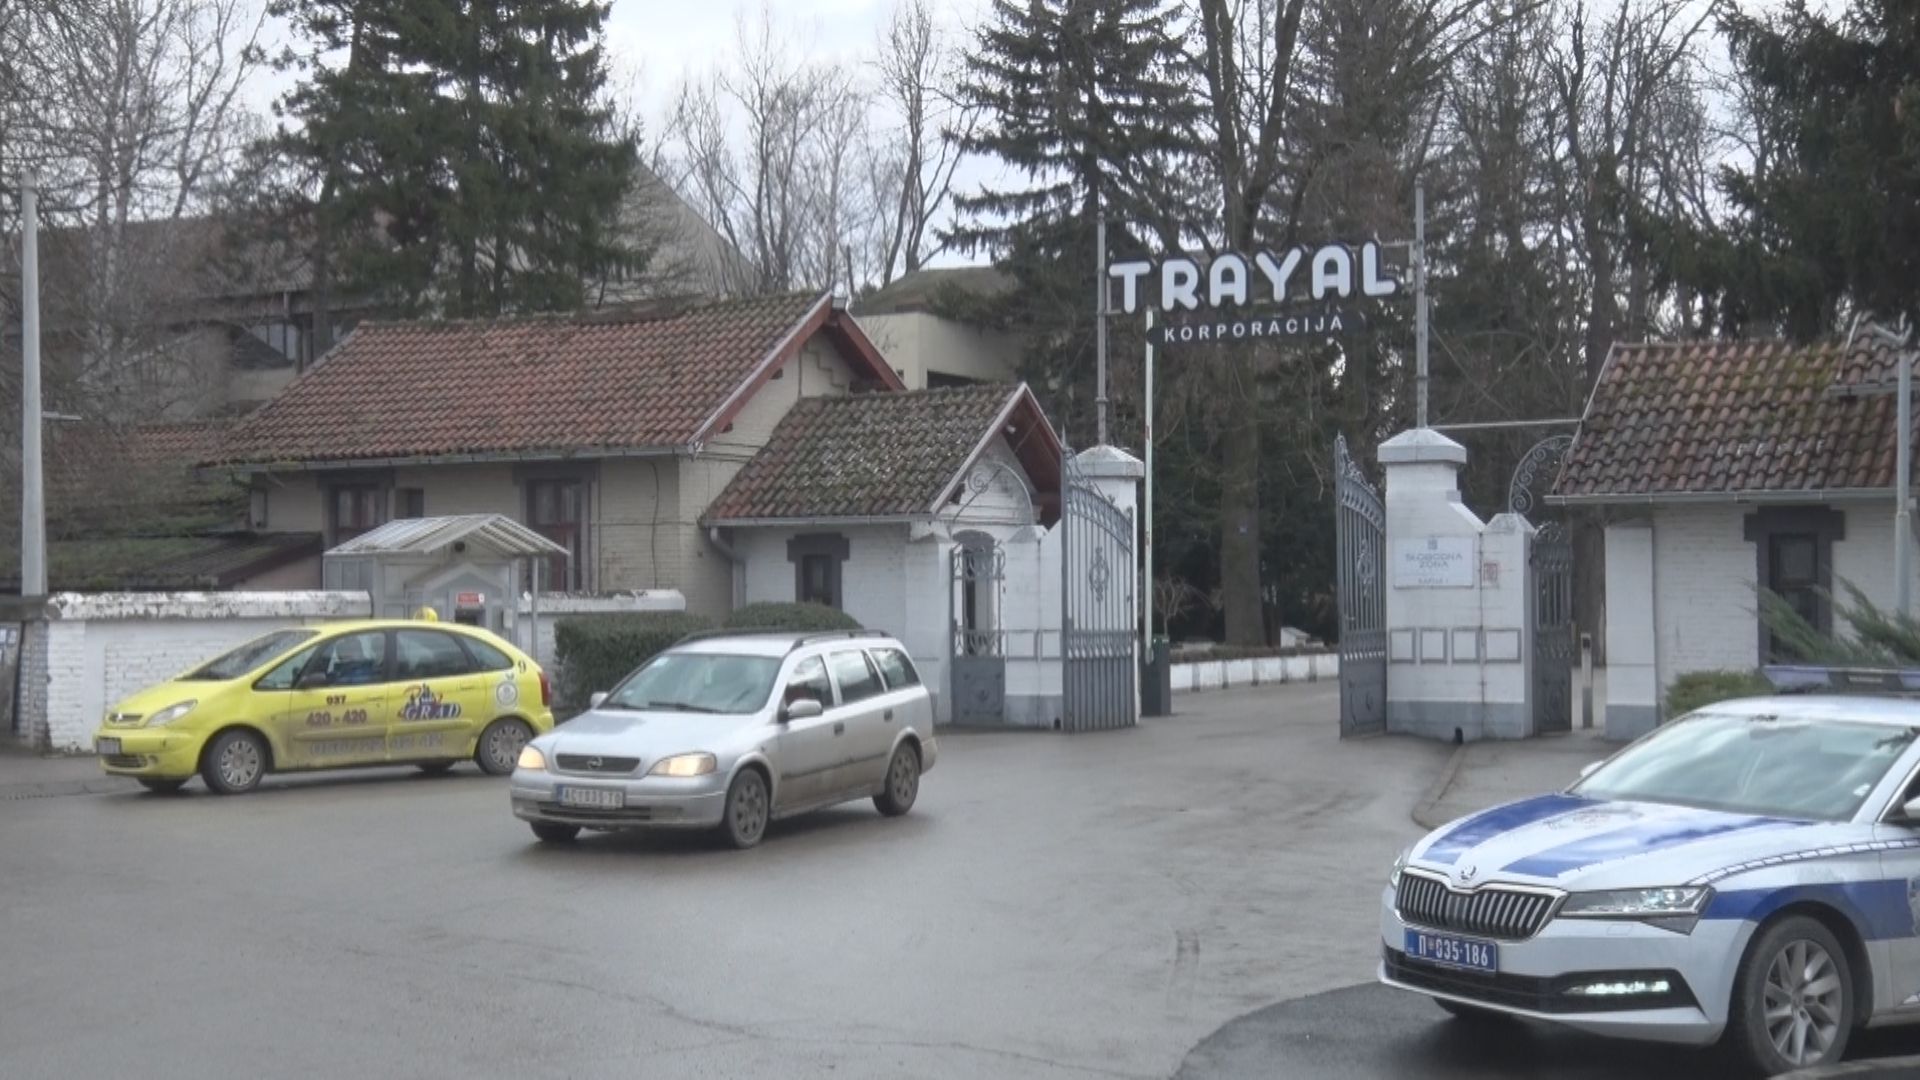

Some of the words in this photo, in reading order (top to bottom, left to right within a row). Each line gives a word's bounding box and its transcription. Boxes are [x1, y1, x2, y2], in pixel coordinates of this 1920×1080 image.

[1108, 240, 1397, 314] TRAYAL
[1164, 314, 1344, 343] KORPORACIJA
[518, 660, 527, 673] 9
[326, 695, 346, 705] 037
[405, 702, 461, 721] GRAD
